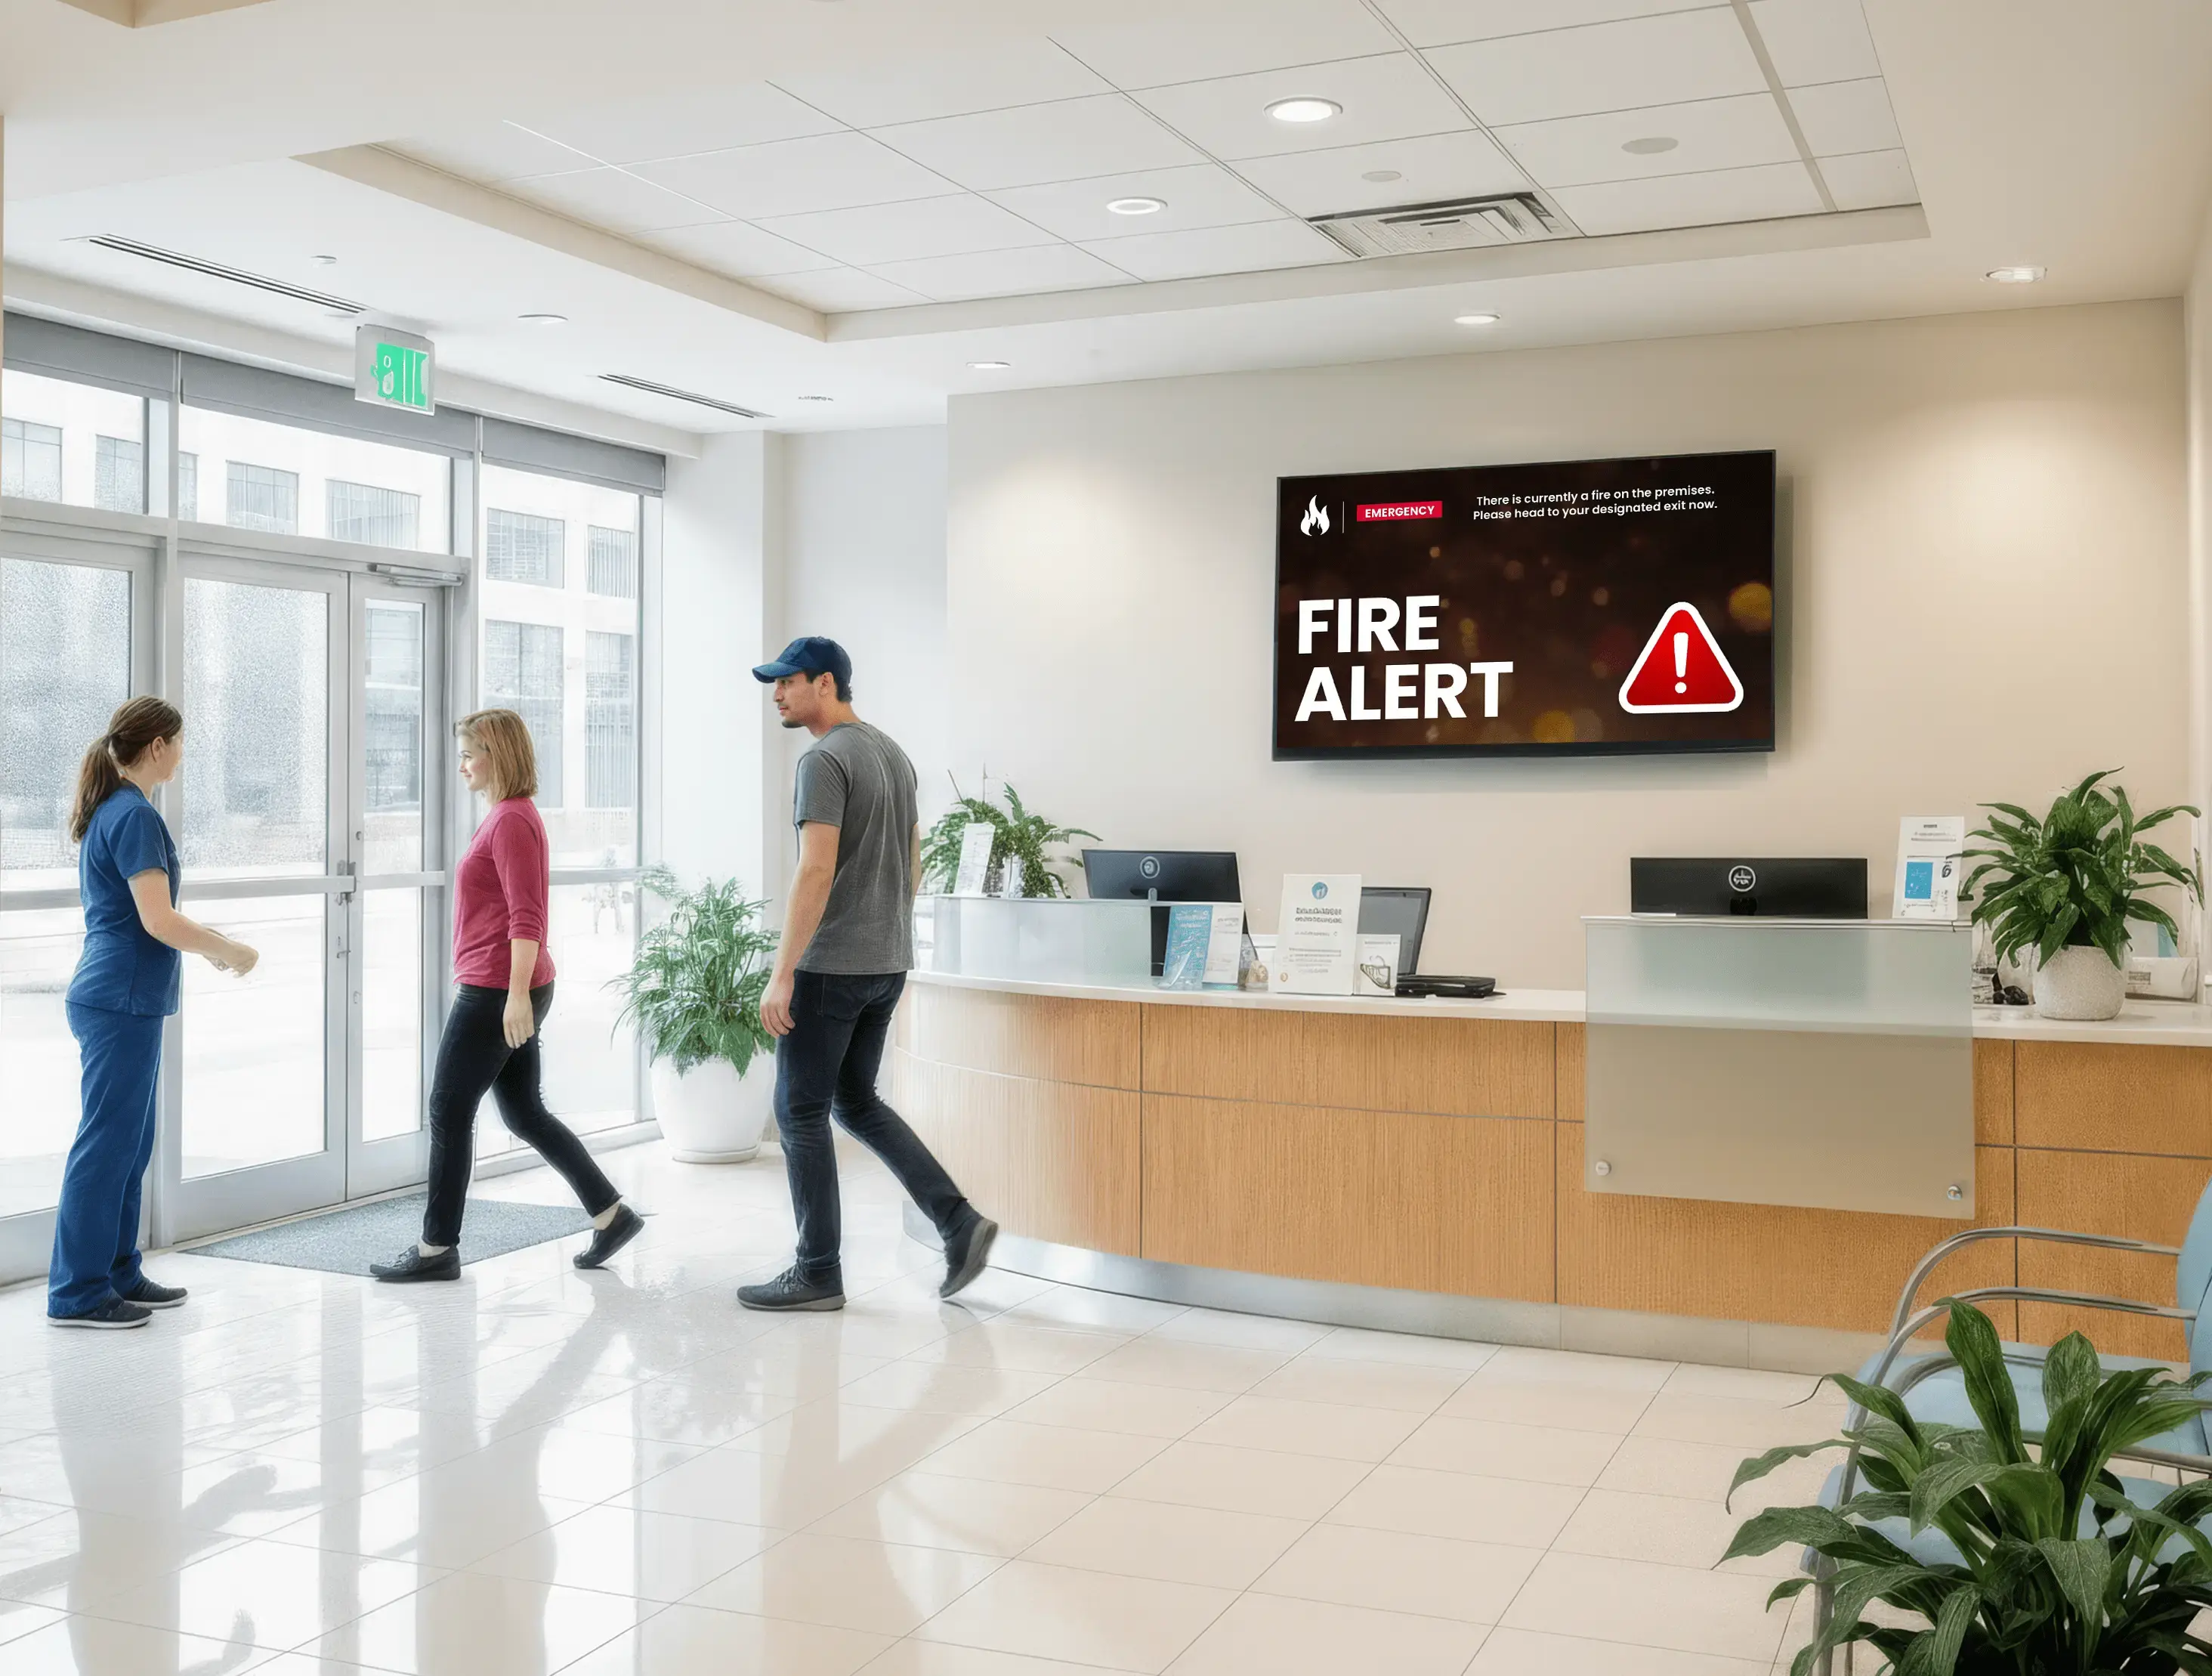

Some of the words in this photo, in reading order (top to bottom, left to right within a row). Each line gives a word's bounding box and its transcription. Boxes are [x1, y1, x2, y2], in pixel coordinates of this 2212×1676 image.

[1476, 496, 1509, 506] There
[1512, 493, 1522, 505] is
[1524, 491, 1578, 505] currently
[1580, 493, 1589, 501] a
[1591, 489, 1611, 500] fire
[1613, 490, 1630, 499] on
[1631, 487, 1652, 498] the
[1654, 484, 1715, 500] premises.
[1365, 506, 1435, 518] EMERGENCY
[1473, 510, 1512, 520] Please
[1514, 507, 1545, 518] head
[1547, 507, 1560, 517] to
[1562, 507, 1589, 519] your
[1592, 501, 1661, 516] designated
[1664, 499, 1686, 511] exit
[1688, 501, 1718, 510] now.
[1298, 595, 1440, 654] FIRE
[1294, 660, 1514, 722] ALERT
